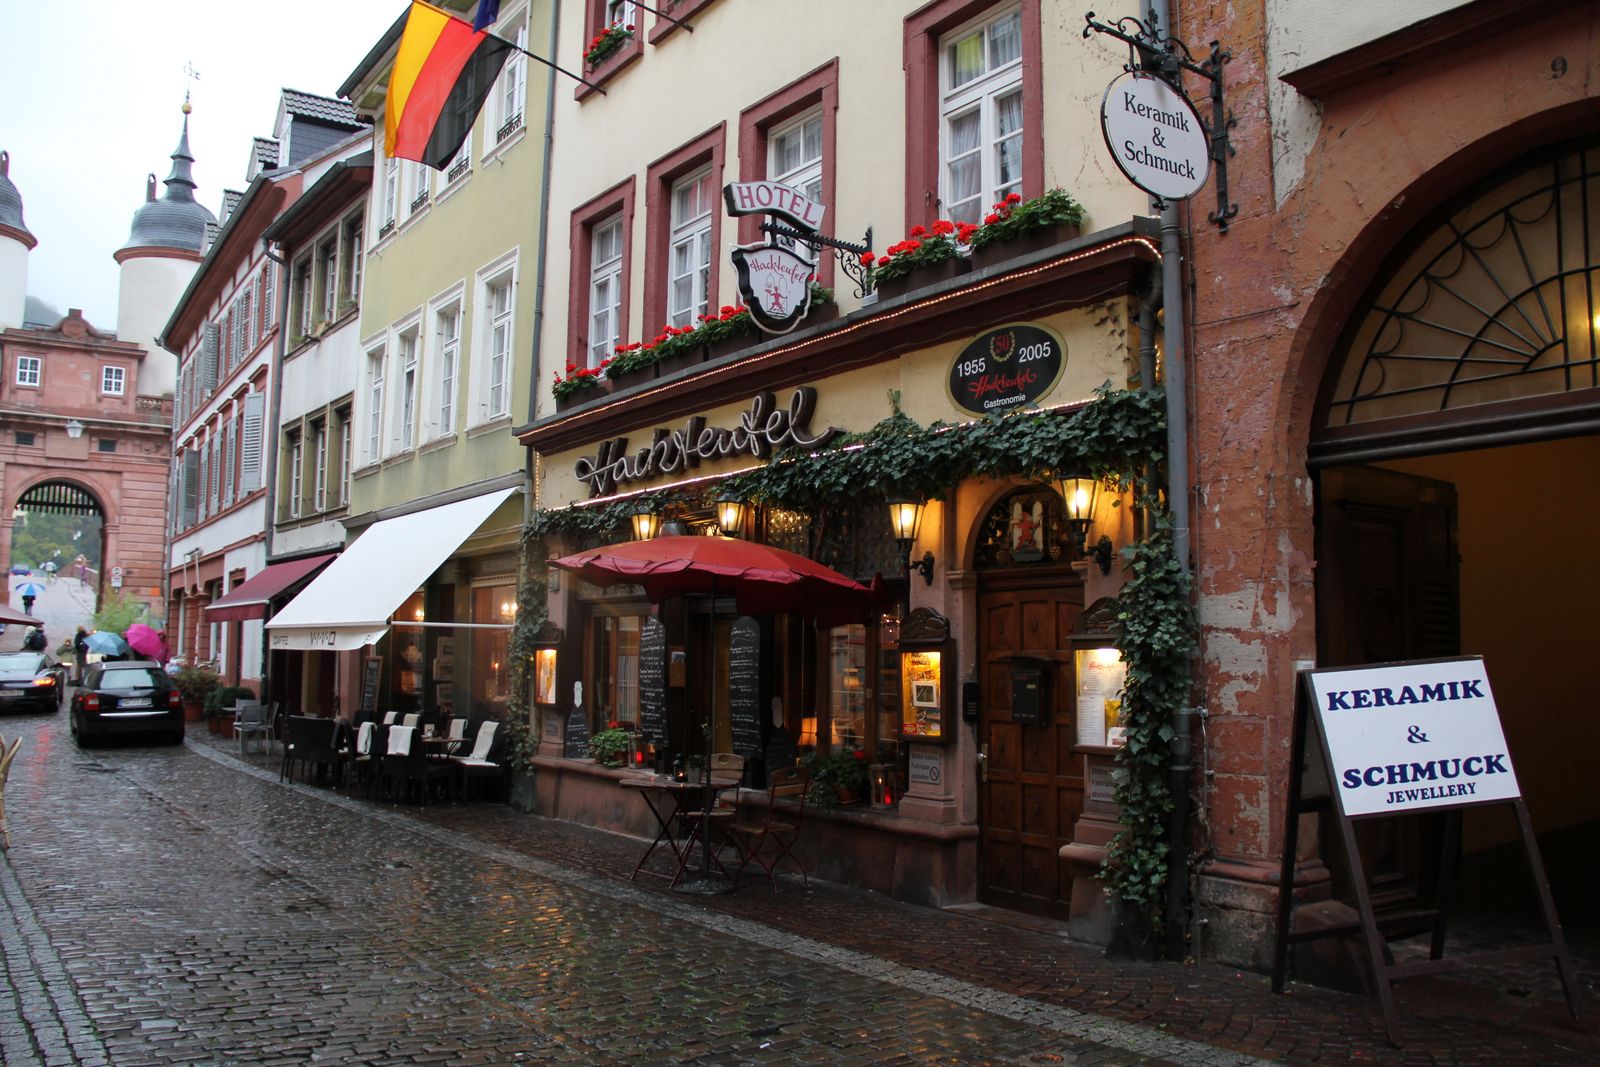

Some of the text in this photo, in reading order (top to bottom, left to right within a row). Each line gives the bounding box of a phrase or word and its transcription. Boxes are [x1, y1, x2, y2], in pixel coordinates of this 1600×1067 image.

[1551, 56, 1568, 79] 9
[1124, 92, 1190, 133] Keramik
[1152, 127, 1166, 148] &
[1124, 140, 1196, 180] Schmuck
[736, 184, 817, 226] HOTEL
[750, 254, 806, 284] Hackteufel
[957, 341, 1051, 377] 1955 2005
[983, 393, 1026, 409] Gastronomie
[574, 386, 846, 498] Hackteufel
[1326, 679, 1485, 711] KERAMIK
[1407, 725, 1431, 744] &
[1342, 754, 1508, 788] SCHMUCK
[1386, 782, 1477, 804] JEWELLERY
